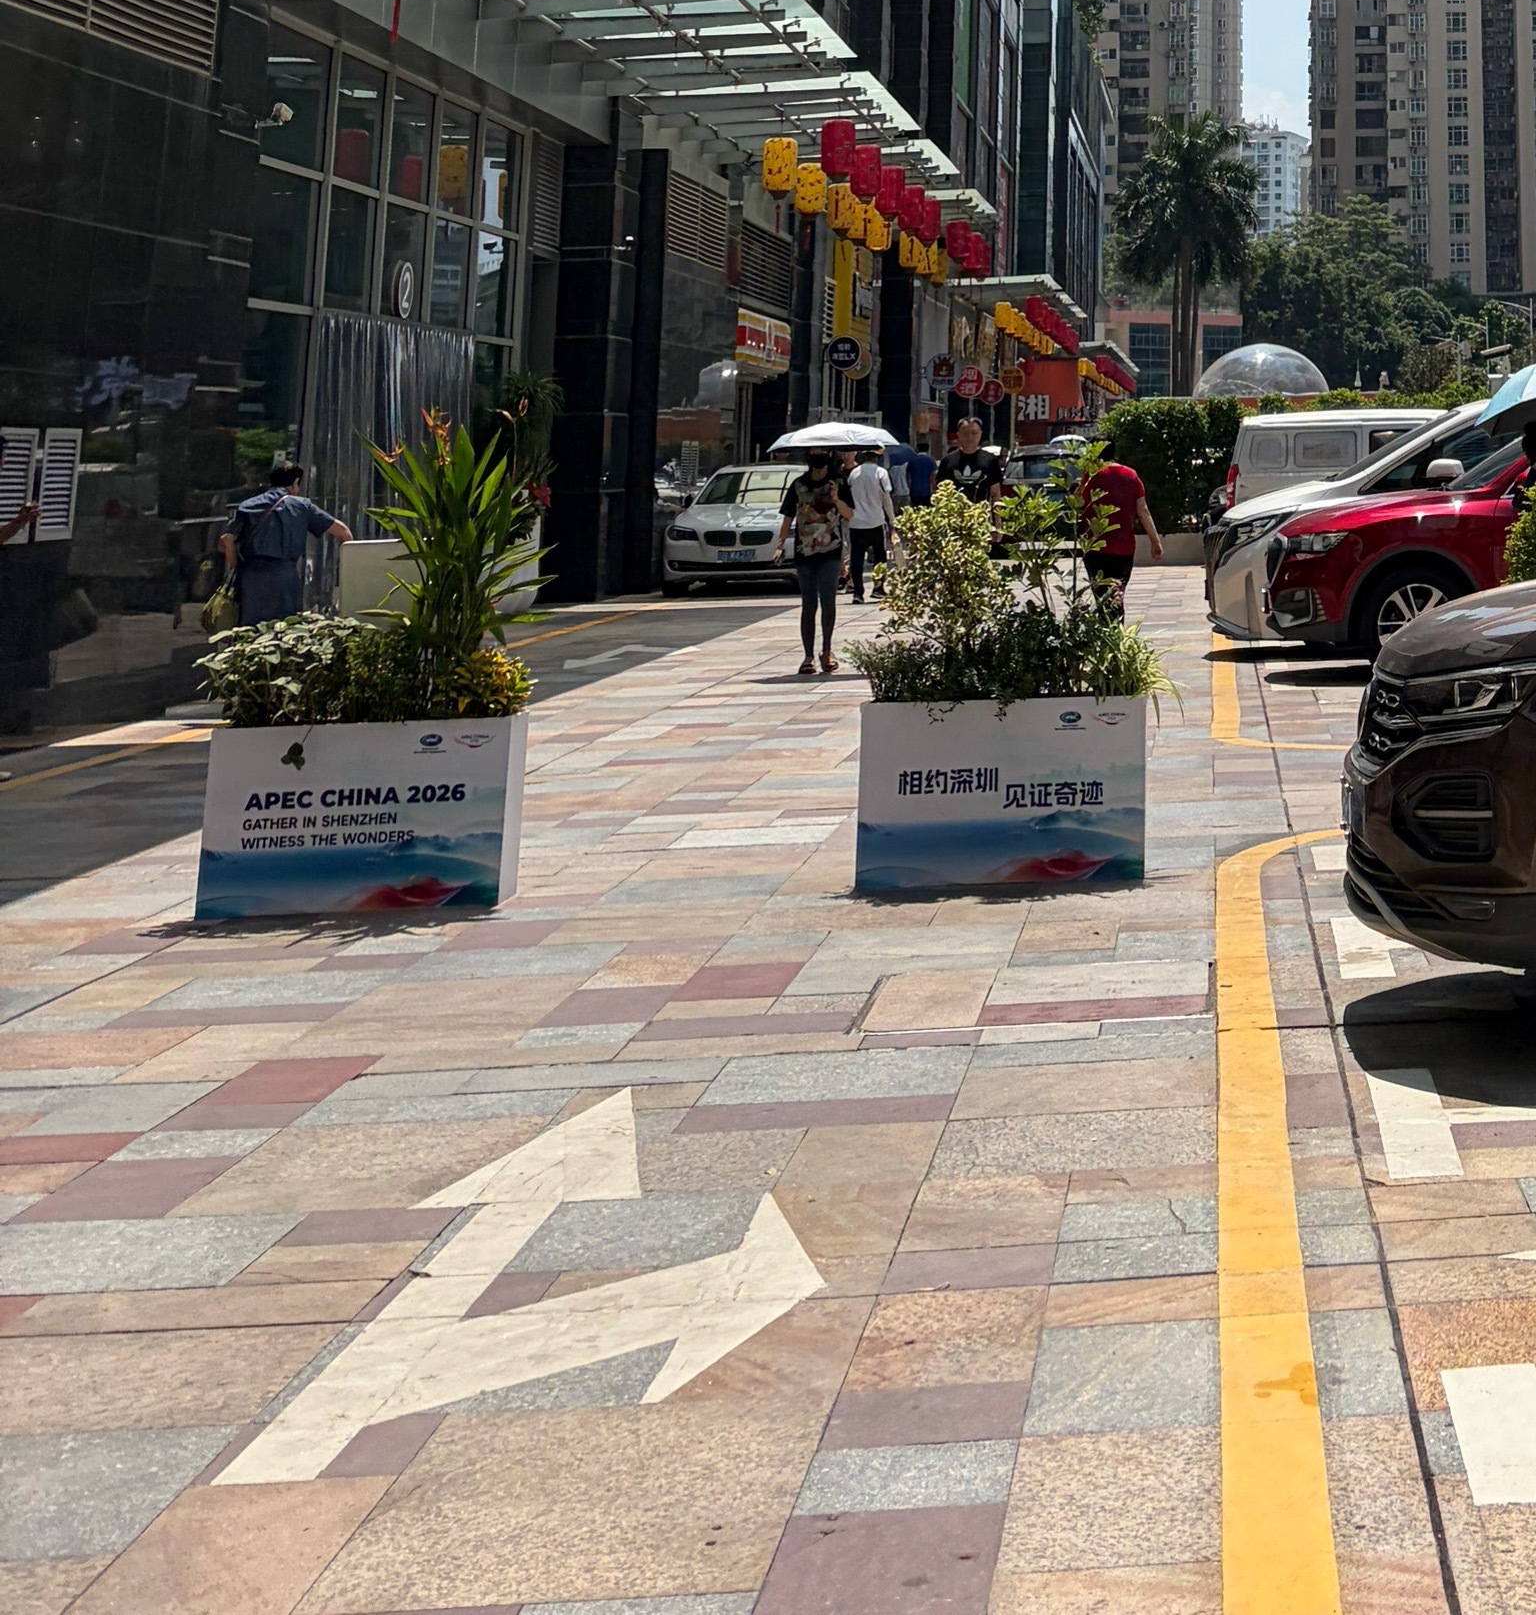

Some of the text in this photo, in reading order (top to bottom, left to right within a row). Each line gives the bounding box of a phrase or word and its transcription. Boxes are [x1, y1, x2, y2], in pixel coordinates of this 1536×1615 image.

[402, 271, 411, 309] 2
[832, 352, 856, 361] RELX
[1017, 394, 1050, 421] 湘
[244, 783, 466, 811] APEC CHINA 2026
[898, 767, 1104, 809] 相约深圳 见证奇迹
[242, 812, 398, 831] GATHER IN SHENZHEN
[241, 829, 415, 850] WITNESS THE WONDERS
